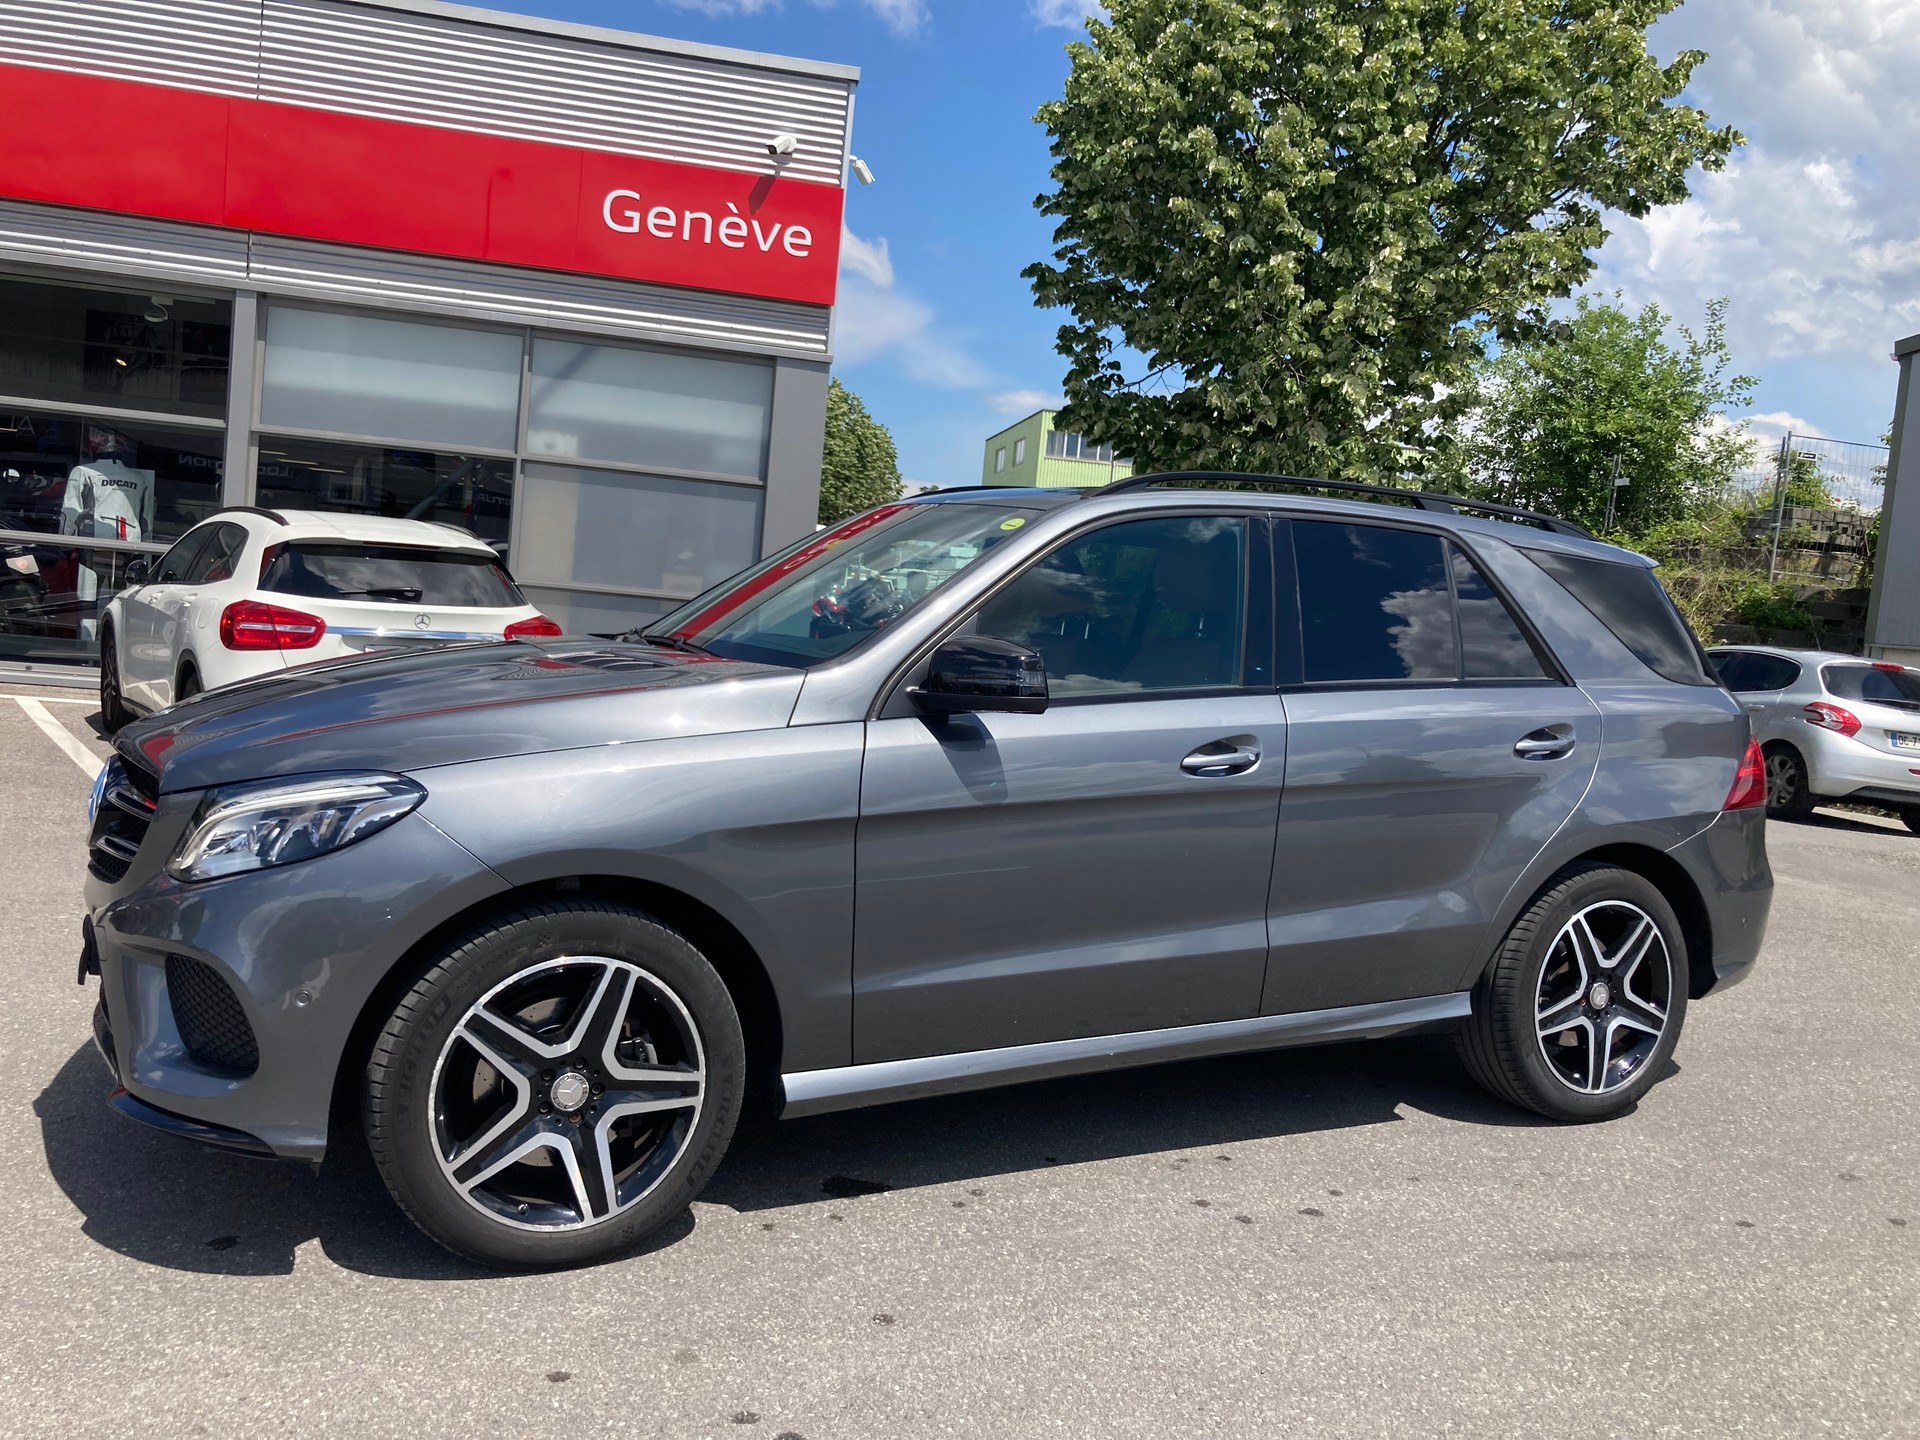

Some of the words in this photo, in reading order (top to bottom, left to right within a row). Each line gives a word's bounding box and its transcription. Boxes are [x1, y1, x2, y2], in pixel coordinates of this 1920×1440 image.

[602, 189, 812, 257] Genève
[101, 479, 138, 490] DUCATI
[1898, 735, 1920, 747] DC-7
[397, 996, 449, 1108] MICHELIN
